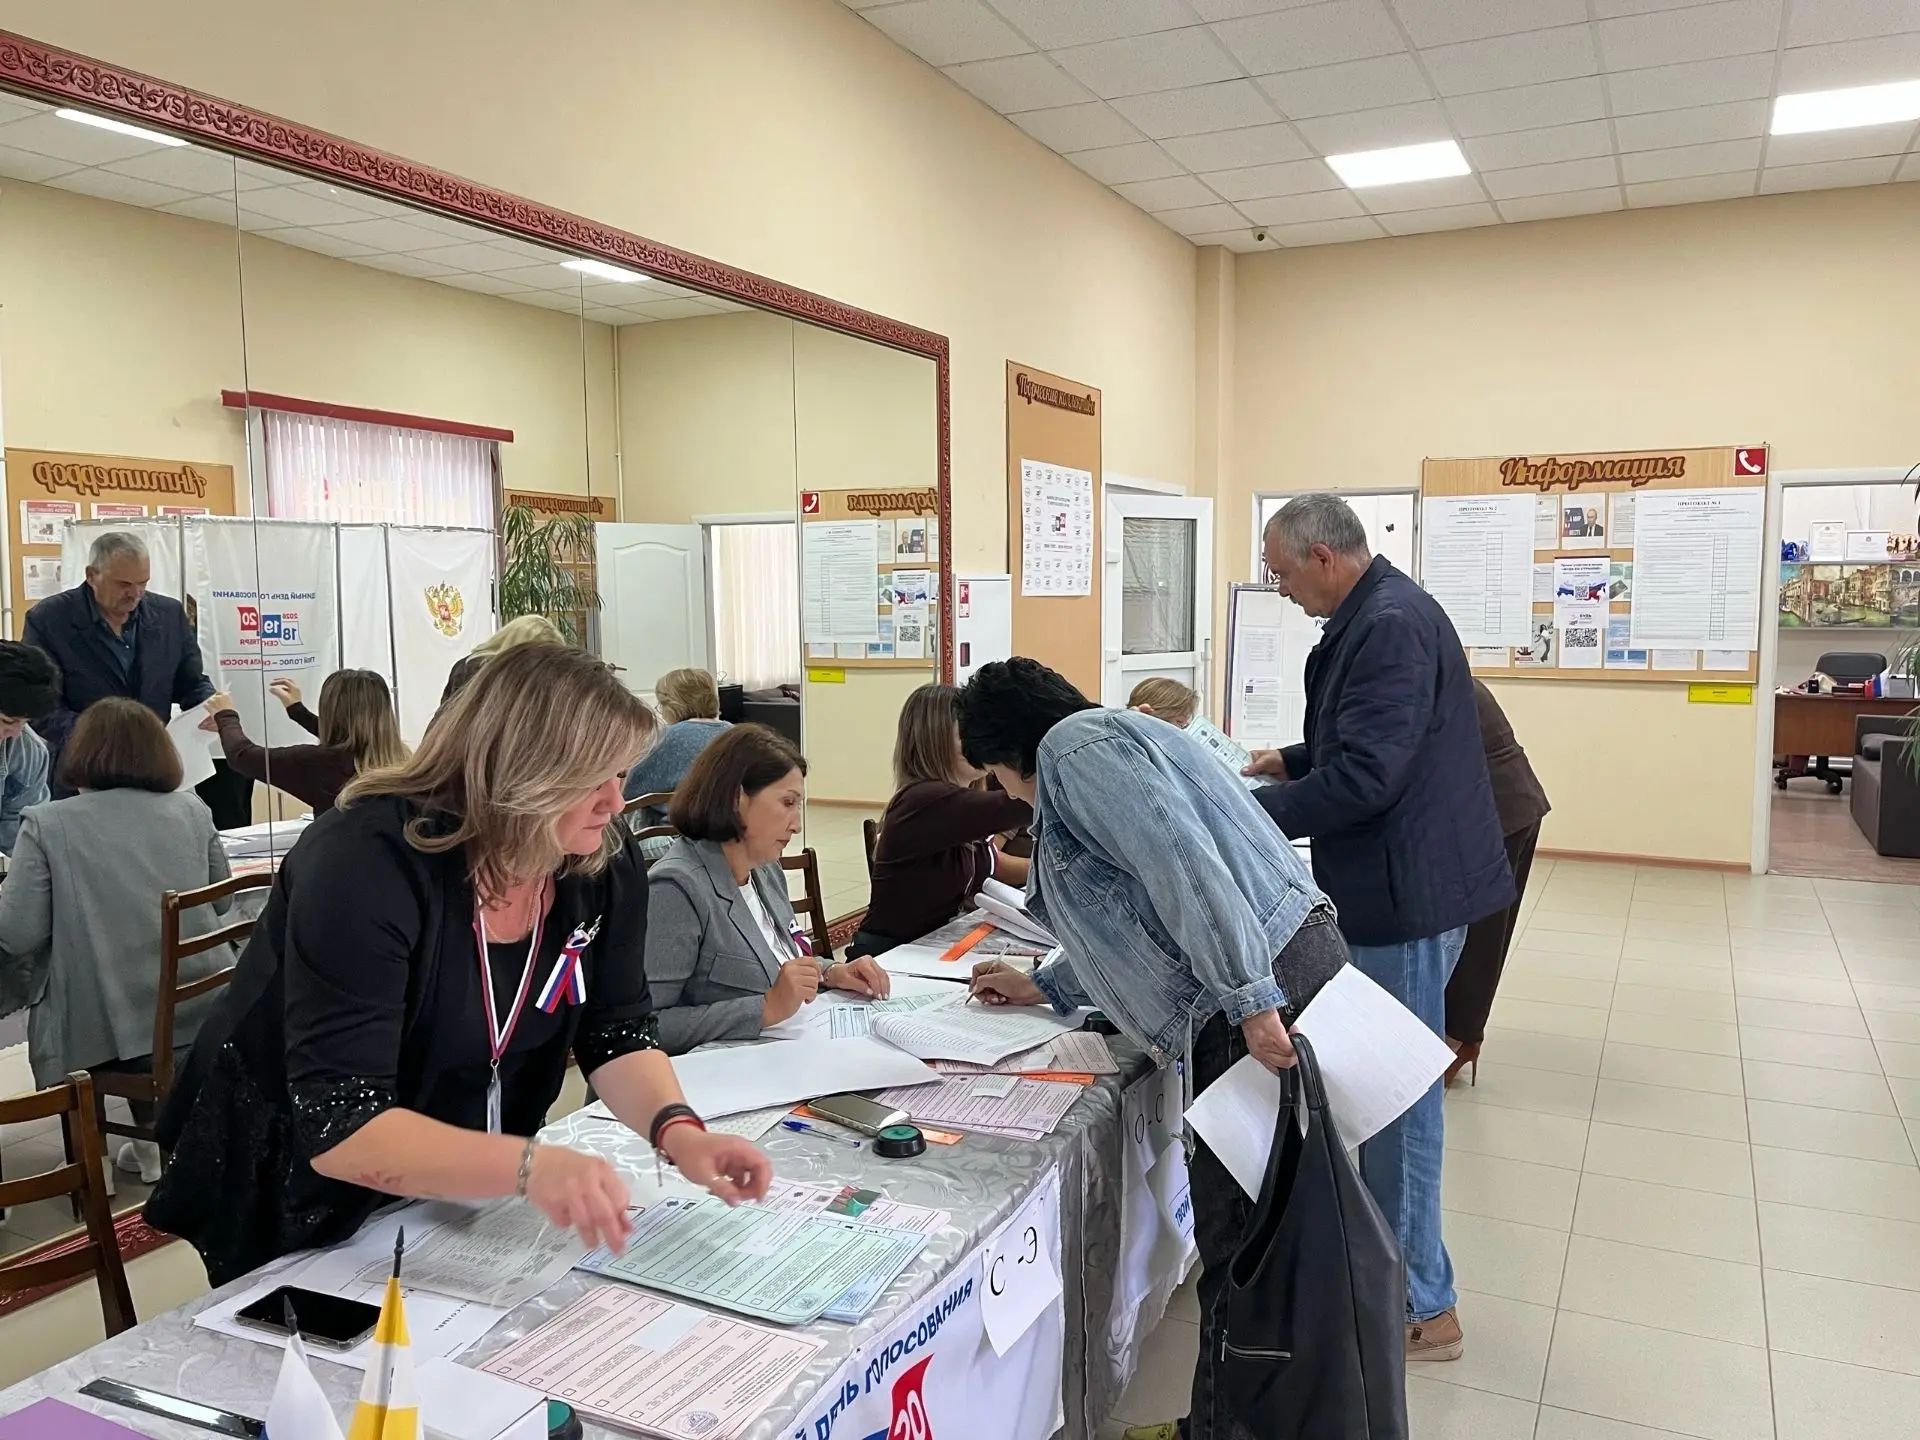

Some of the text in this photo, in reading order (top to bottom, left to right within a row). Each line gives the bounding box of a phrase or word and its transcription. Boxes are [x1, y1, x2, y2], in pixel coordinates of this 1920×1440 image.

[1500, 456, 1686, 492] Информация
[1174, 1195, 1191, 1228] ТВОЙ
[865, 1277, 973, 1394] ГОЛОСОВАНИЯ
